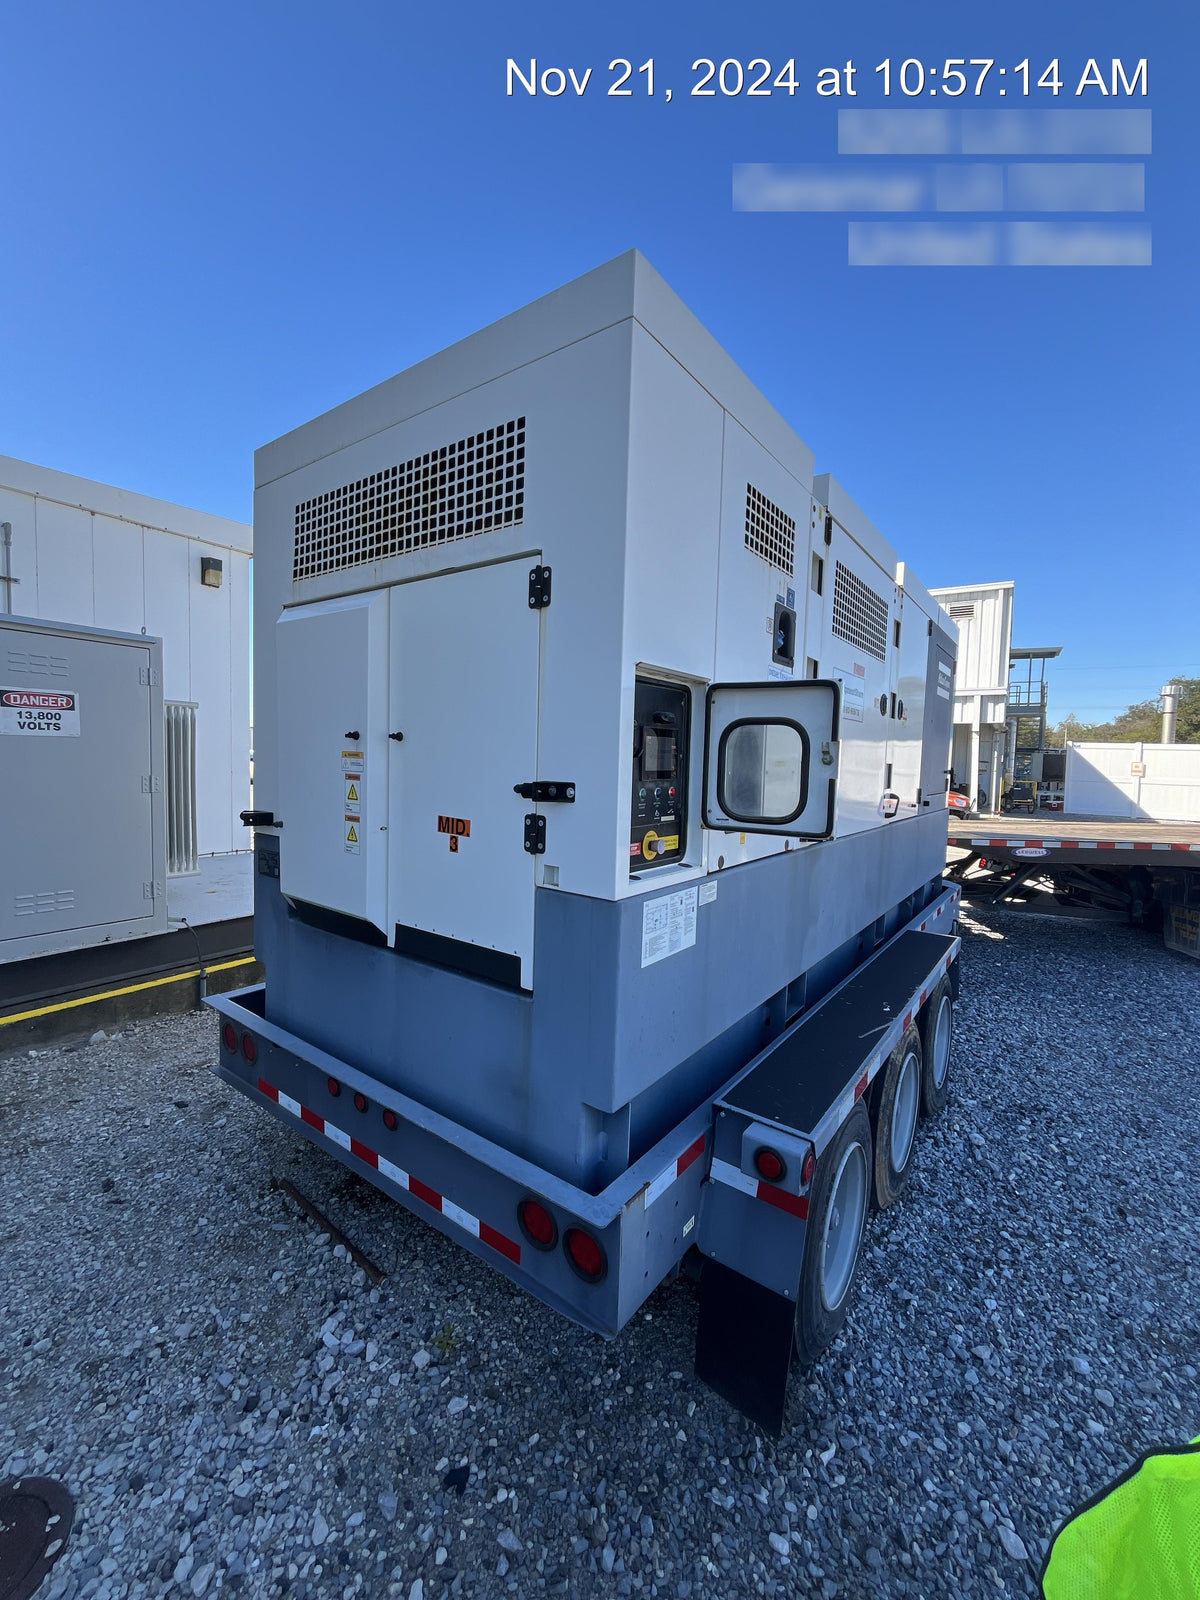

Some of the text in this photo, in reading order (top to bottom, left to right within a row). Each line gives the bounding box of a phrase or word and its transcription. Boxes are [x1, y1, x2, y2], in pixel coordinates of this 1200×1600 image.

[10, 694, 67, 706] DANGER
[17, 711, 61, 721] 13,800
[17, 721, 61, 731] VOLTS
[438, 815, 470, 837] MID.
[450, 835, 458, 852] 3
